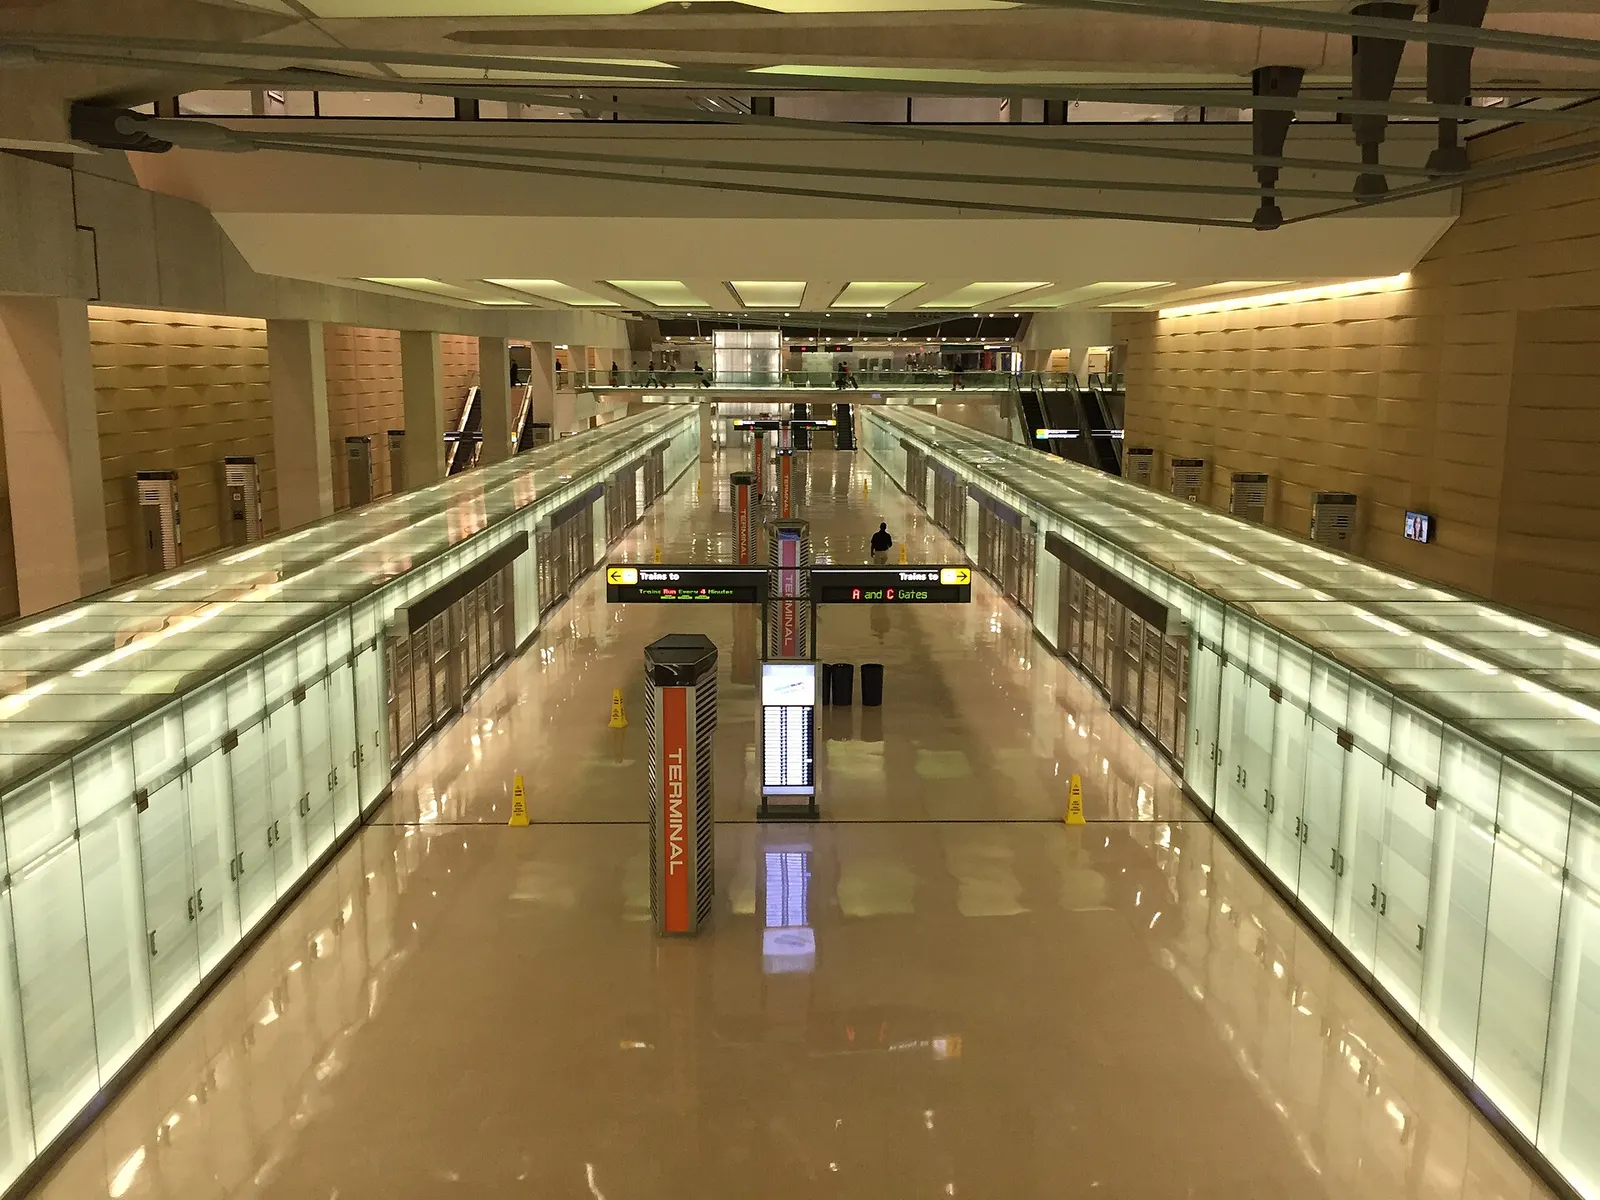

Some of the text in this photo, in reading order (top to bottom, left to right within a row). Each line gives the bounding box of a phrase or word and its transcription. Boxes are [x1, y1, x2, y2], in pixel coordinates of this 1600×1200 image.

[640, 572, 680, 581] Trains to
[899, 572, 939, 581] Trains to
[852, 589, 928, 600] A and C Gates
[784, 575, 793, 646] TERMINAL
[668, 747, 683, 876] TERMINAL
